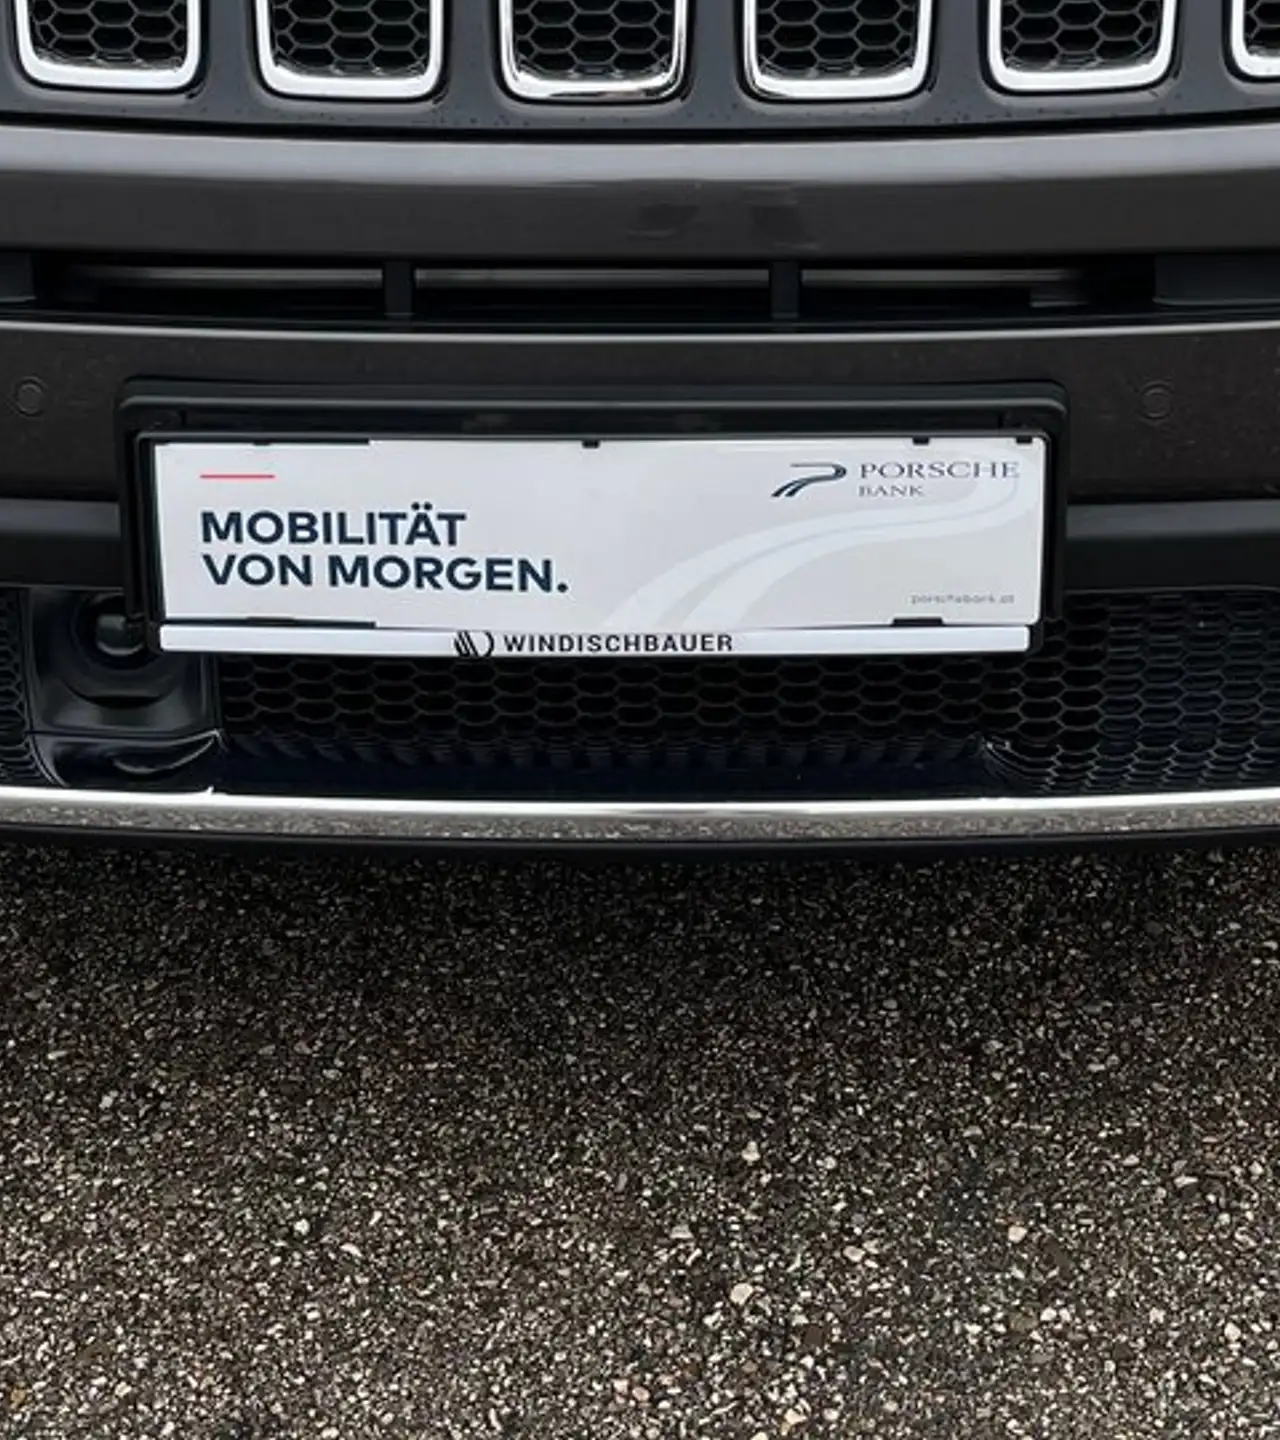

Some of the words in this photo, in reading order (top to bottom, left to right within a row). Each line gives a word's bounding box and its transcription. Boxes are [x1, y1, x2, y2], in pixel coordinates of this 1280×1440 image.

[859, 461, 1019, 479] PORSCHE
[858, 484, 925, 498] BANK
[200, 502, 467, 546] MOBILITÄT
[202, 554, 313, 587] VON
[329, 554, 569, 594] MORGEN.
[503, 632, 733, 653] WINDISCHBAUER
